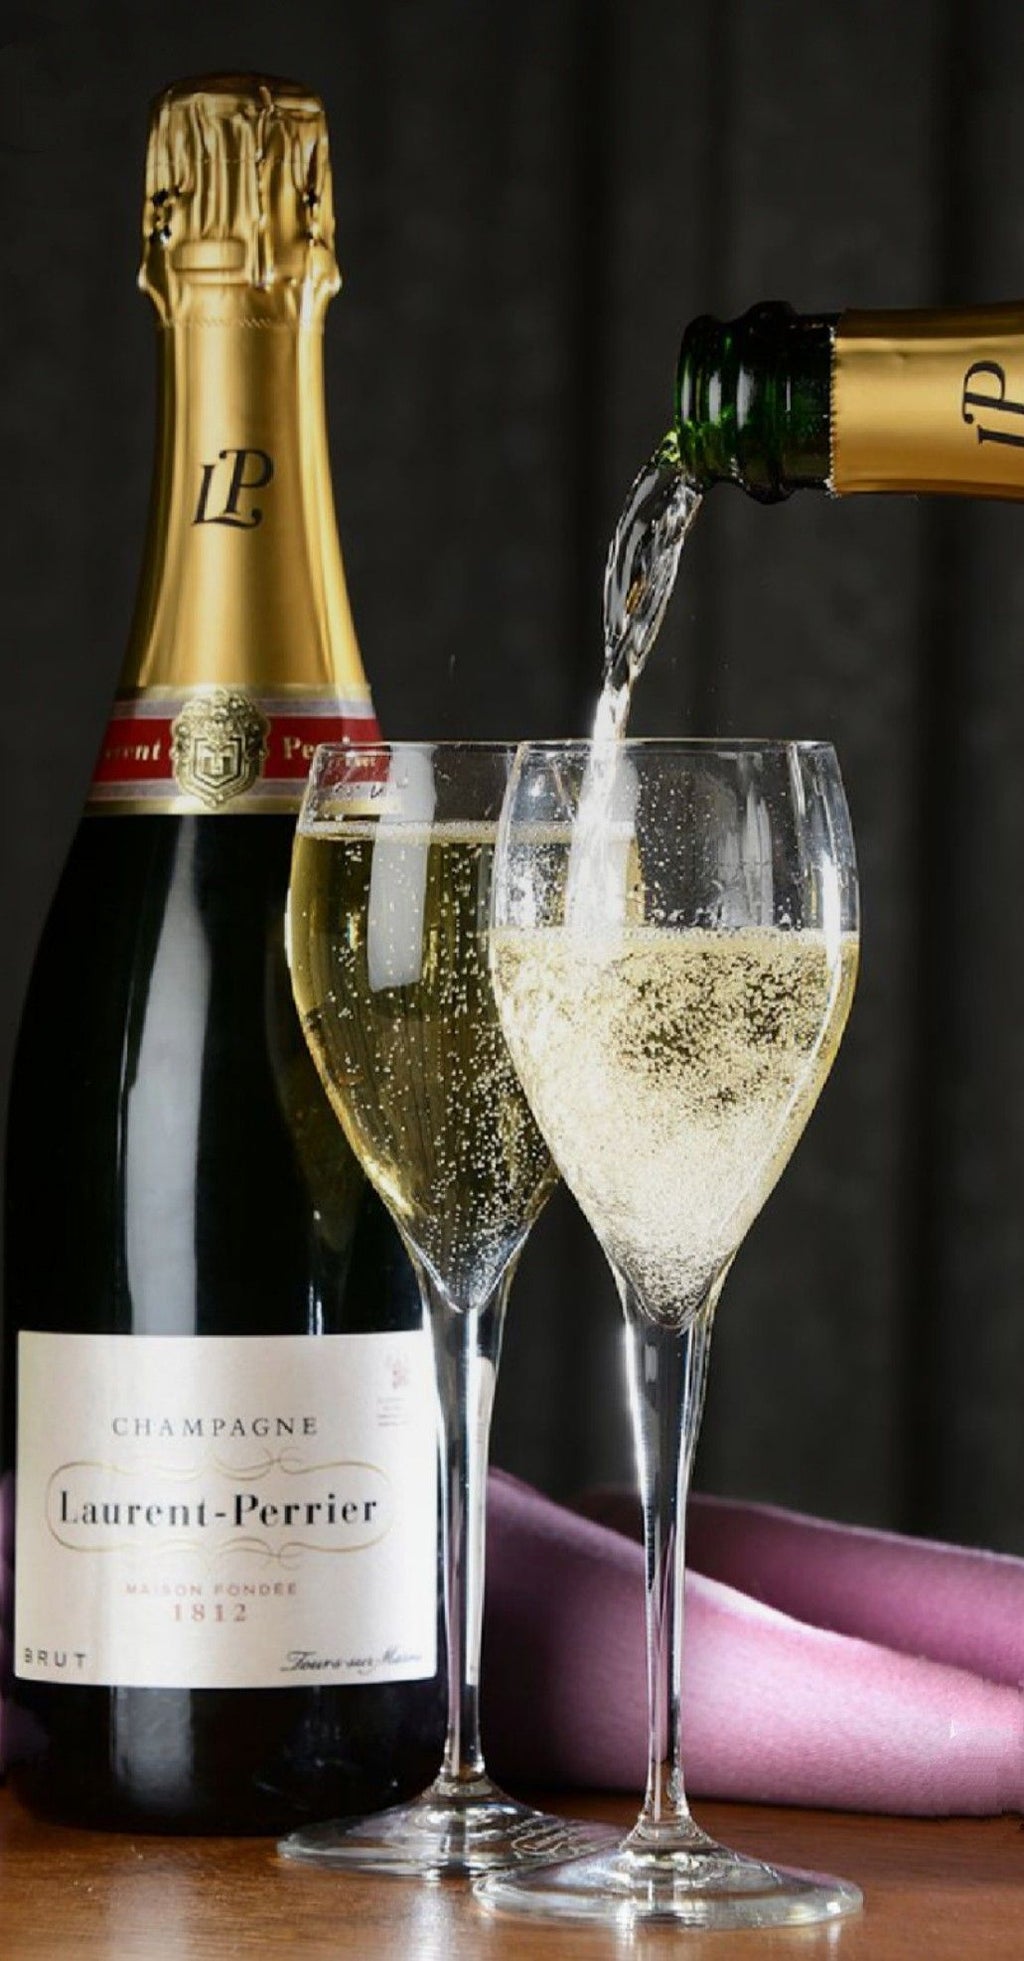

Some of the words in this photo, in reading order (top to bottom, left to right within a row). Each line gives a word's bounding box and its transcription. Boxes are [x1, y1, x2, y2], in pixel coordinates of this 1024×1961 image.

[192, 448, 274, 528] LP
[112, 1416, 319, 1437] CHAMPAGNE
[60, 1489, 378, 1527] Laurent-Perrier
[126, 1583, 202, 1597] MAISON
[173, 1603, 247, 1623] 1812
[24, 1647, 86, 1669] BRUT
